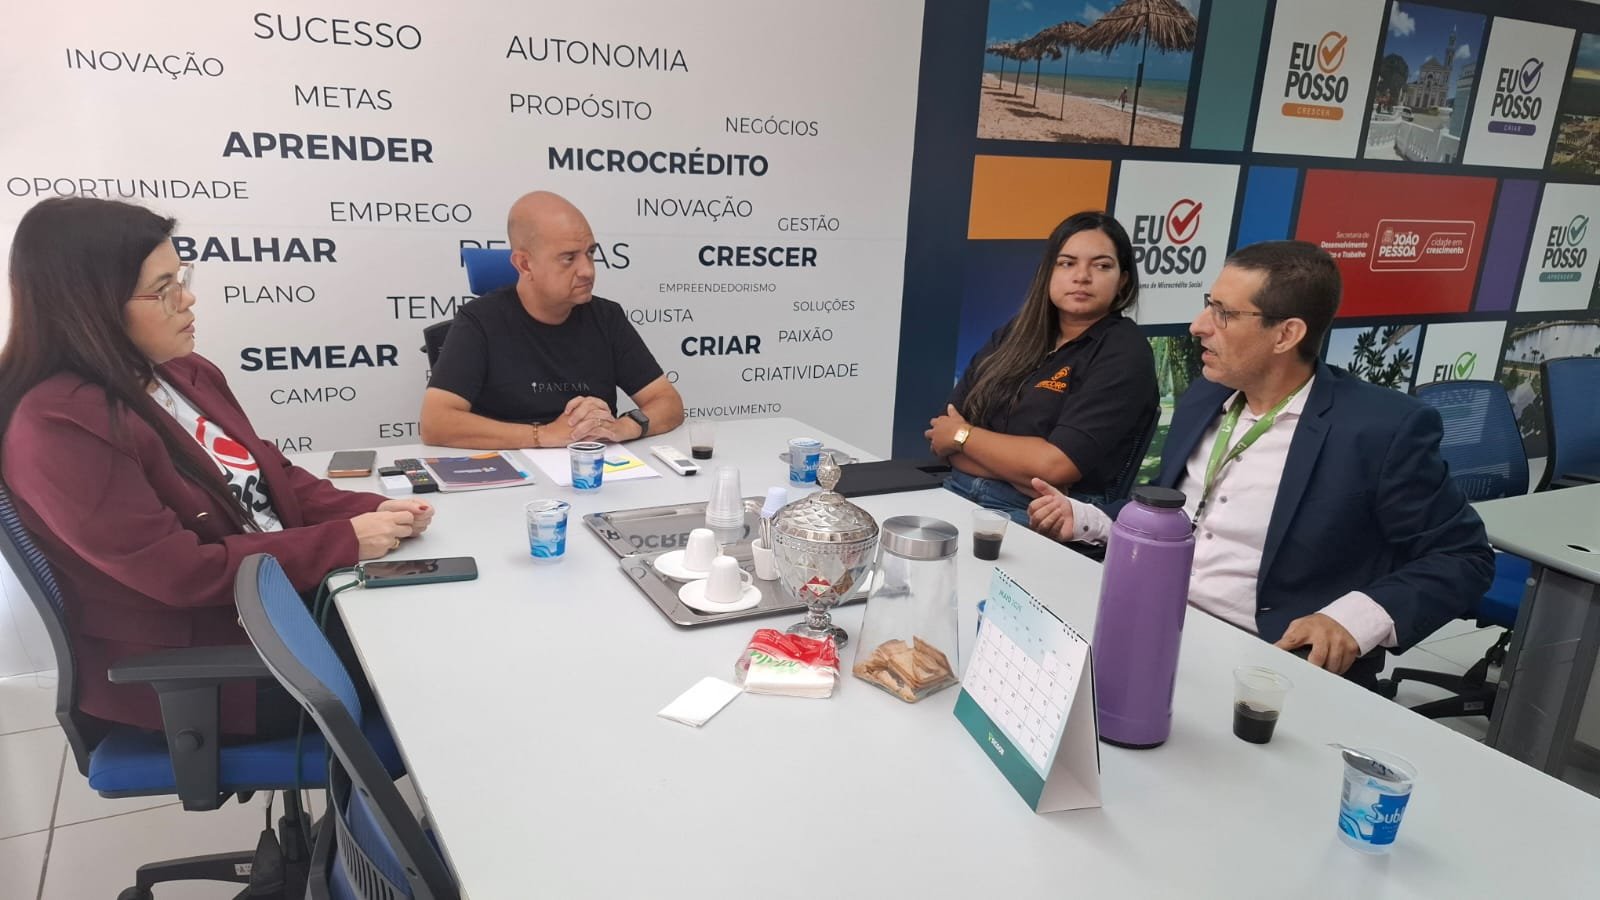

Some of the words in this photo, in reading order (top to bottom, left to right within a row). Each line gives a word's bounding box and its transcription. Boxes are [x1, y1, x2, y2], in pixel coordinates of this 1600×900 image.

[254, 12, 422, 50] SUCESSO
[66, 48, 224, 81] INOVAÇÃO
[505, 35, 689, 72] AUTONOMIA
[1288, 41, 1317, 71] EU
[1284, 70, 1349, 103] POSSO
[1496, 67, 1518, 94] EU
[294, 84, 393, 111] METAS
[509, 93, 652, 121] PROPÓSITO
[1490, 93, 1542, 120] POSSO
[725, 115, 819, 137] NEGÓCIOS
[222, 131, 434, 164] APRENDER
[548, 146, 769, 177] MICROCRÉDITO
[6, 176, 249, 200] OPORTUNIDADE
[330, 201, 472, 223] EMPREGO
[637, 195, 753, 223] INOVAÇÃO
[777, 214, 840, 232] GESTÃO
[1131, 215, 1165, 245] EU
[1393, 231, 1420, 246] JOÃO
[1431, 238, 1451, 246] cidade
[1547, 226, 1568, 247] EU
[698, 244, 818, 268] CRESCER
[1133, 245, 1207, 275] POSSO
[1379, 246, 1416, 257] PESSOA
[1426, 246, 1464, 254] crescimento
[1542, 248, 1587, 268] POSSO
[224, 285, 316, 304] PLANO
[659, 282, 777, 293] EMPREENDEDORISMO
[792, 298, 856, 314] SOLUÇÕES
[681, 334, 762, 357] CRIAR
[778, 326, 834, 344] PAIXÃO
[240, 343, 399, 372] SEMEAR
[741, 362, 859, 383] CRIATIVIDADE
[269, 386, 357, 405] CAMPO
